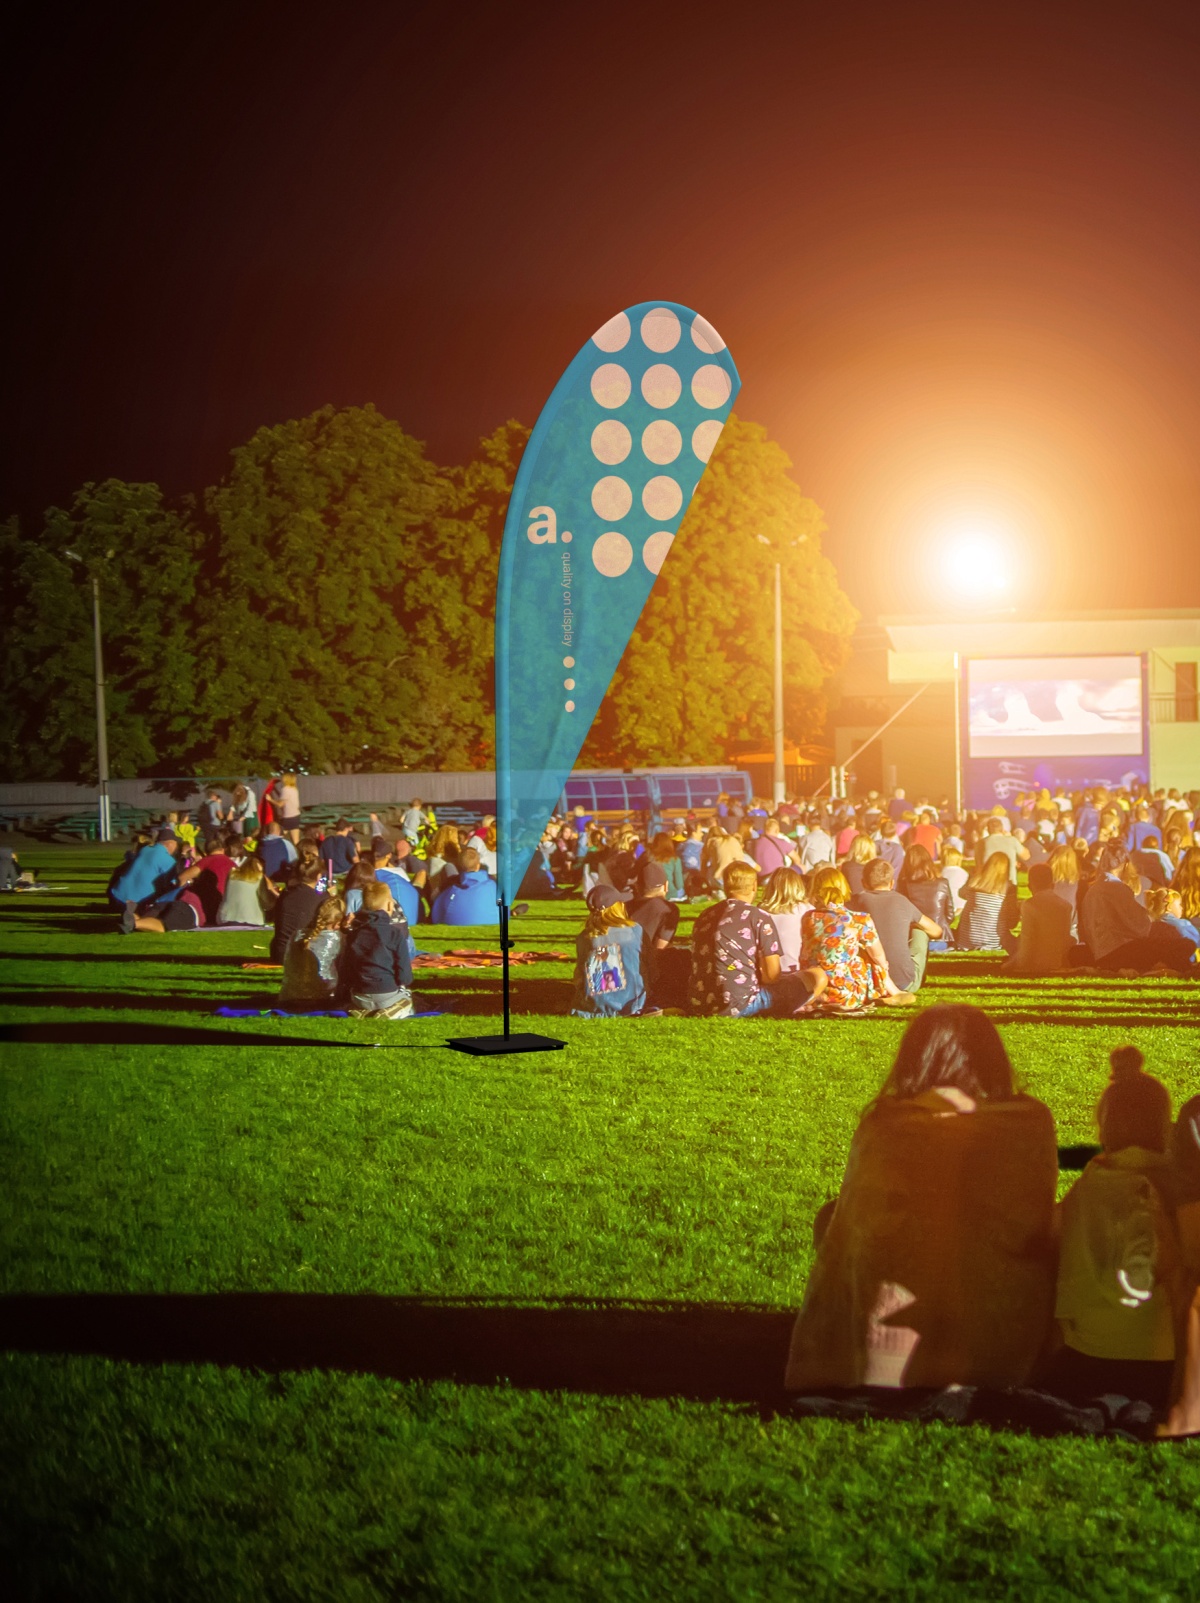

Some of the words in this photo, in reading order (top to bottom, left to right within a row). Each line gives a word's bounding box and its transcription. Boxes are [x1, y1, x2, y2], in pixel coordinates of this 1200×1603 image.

[527, 506, 573, 545] a.
[561, 552, 574, 589] quality
[563, 591, 572, 606] on
[561, 608, 575, 647] display
